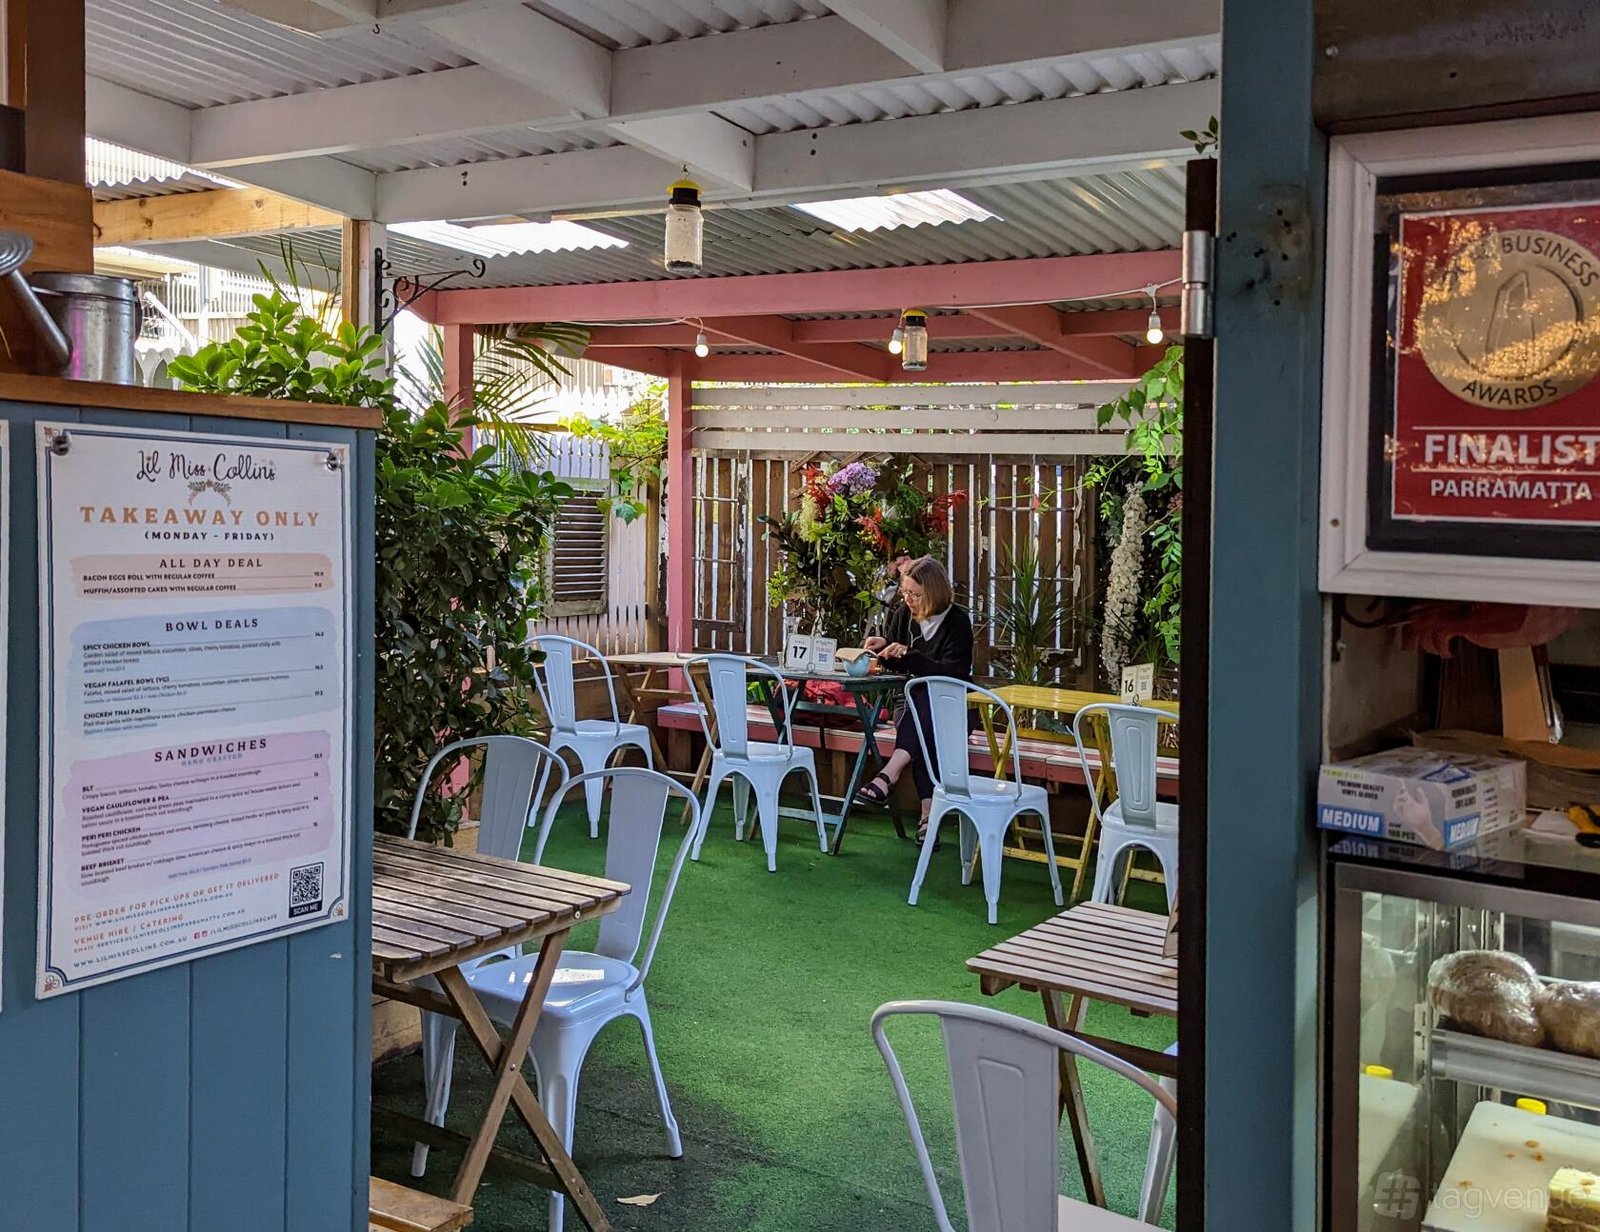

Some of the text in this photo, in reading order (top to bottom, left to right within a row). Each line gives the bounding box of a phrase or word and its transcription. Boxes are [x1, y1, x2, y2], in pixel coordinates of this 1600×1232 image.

[1501, 235, 1600, 288] BUSINESS
[1461, 378, 1558, 406] AWARDS
[1424, 433, 1600, 466] FINALIST
[137, 450, 160, 482] Lil
[169, 451, 206, 480] Miss
[1430, 479, 1593, 502] PARRAMATTA
[80, 506, 320, 527] TAKEAWAY ONLY
[145, 531, 208, 541] (MONDAY
[225, 532, 275, 542] FRIDAY)
[159, 558, 262, 569] ALL DAY DEAL
[83, 574, 107, 582] BACON
[193, 572, 215, 580] COFFEE
[165, 618, 259, 632] BOWL DEALS
[83, 641, 150, 651] SPICY CHICKEN BOWL
[792, 646, 808, 660] 17
[83, 681, 107, 690] VEGAN
[108, 680, 134, 688] FALAFEL
[136, 678, 154, 686] BOWL
[1124, 678, 1134, 694] 16
[83, 712, 113, 721] CHICKEN
[114, 710, 130, 718] THAI
[154, 738, 267, 763] SANDWICHES
[82, 805, 104, 814] VEGAN
[106, 797, 150, 810] CAULIFLOWER
[1321, 809, 1380, 833] MEDIUM
[82, 826, 140, 842] PERI PERI CHICKEN
[81, 858, 124, 871] BEEF BRISKET
[74, 906, 125, 923] PRE-ORDER
[129, 901, 146, 911] FOR
[150, 892, 189, 906] PICK-UPS
[193, 888, 203, 897] OR
[207, 884, 222, 893] GET
[236, 872, 278, 887] DELIVERED
[292, 902, 318, 915] SCAN ME
[74, 932, 103, 945] VENUE
[108, 926, 128, 937] HIRE
[140, 913, 183, 930] CATERING
